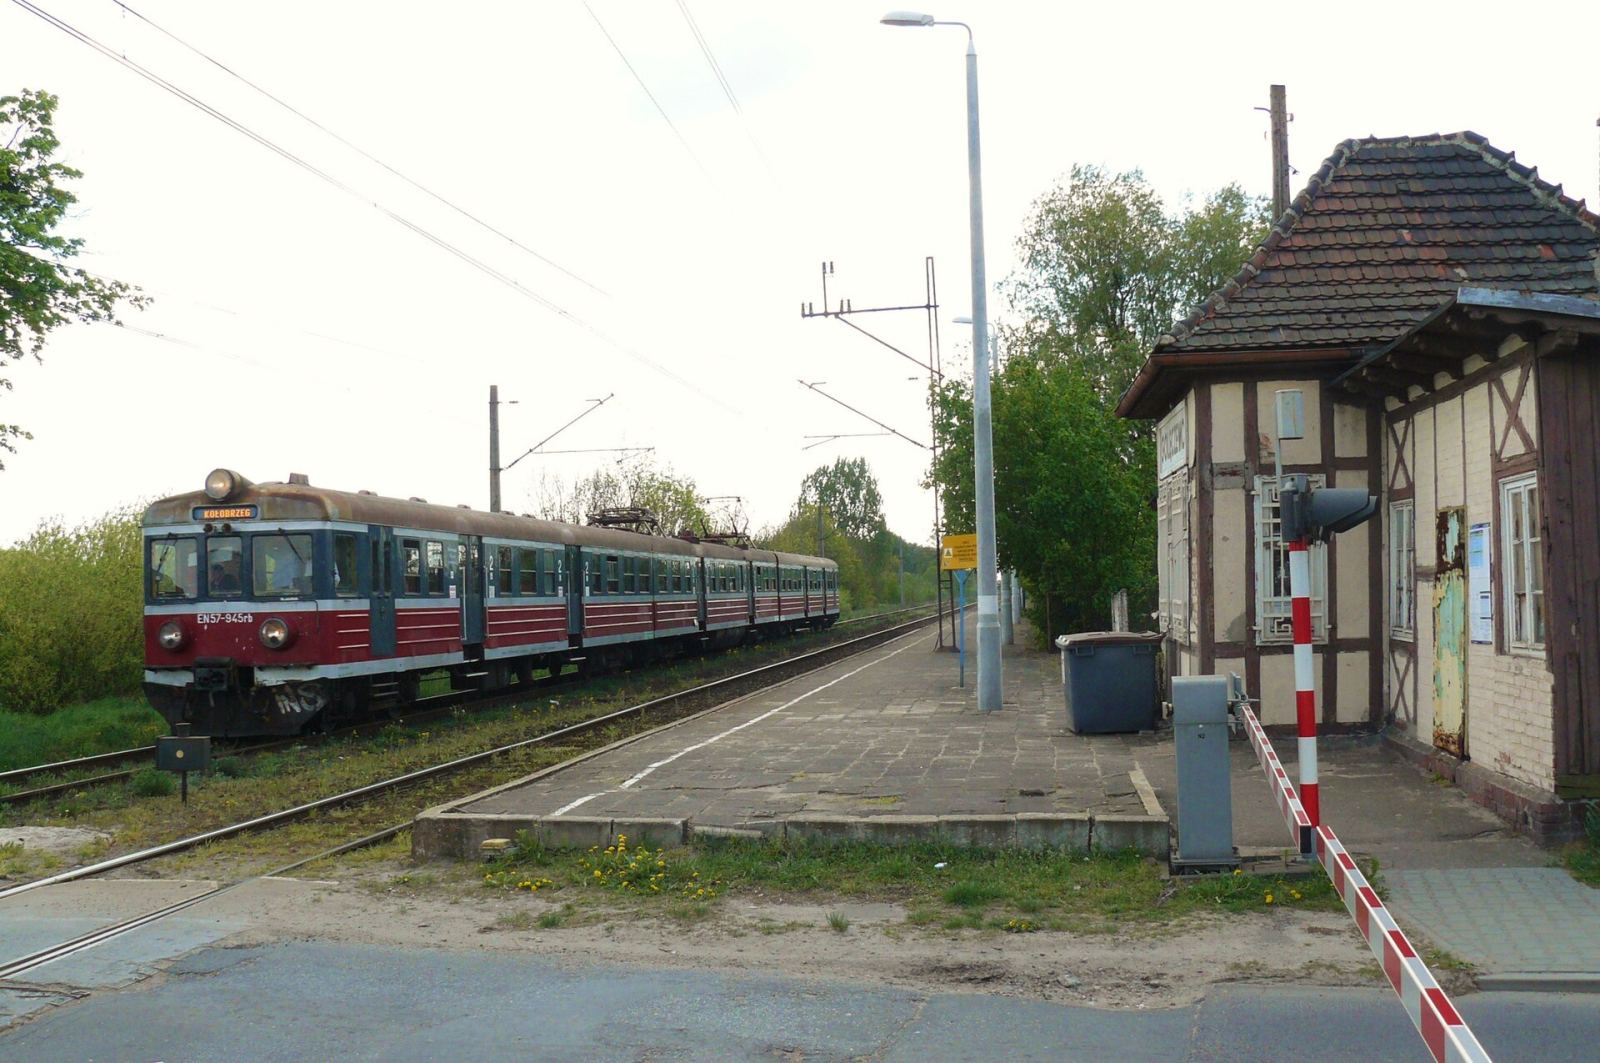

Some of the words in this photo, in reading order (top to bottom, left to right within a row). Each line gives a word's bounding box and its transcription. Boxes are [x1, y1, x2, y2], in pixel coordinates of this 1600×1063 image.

[203, 508, 251, 519] KOŁOBRZEG
[489, 555, 494, 571] 2
[196, 613, 253, 624] EN57-945rb
